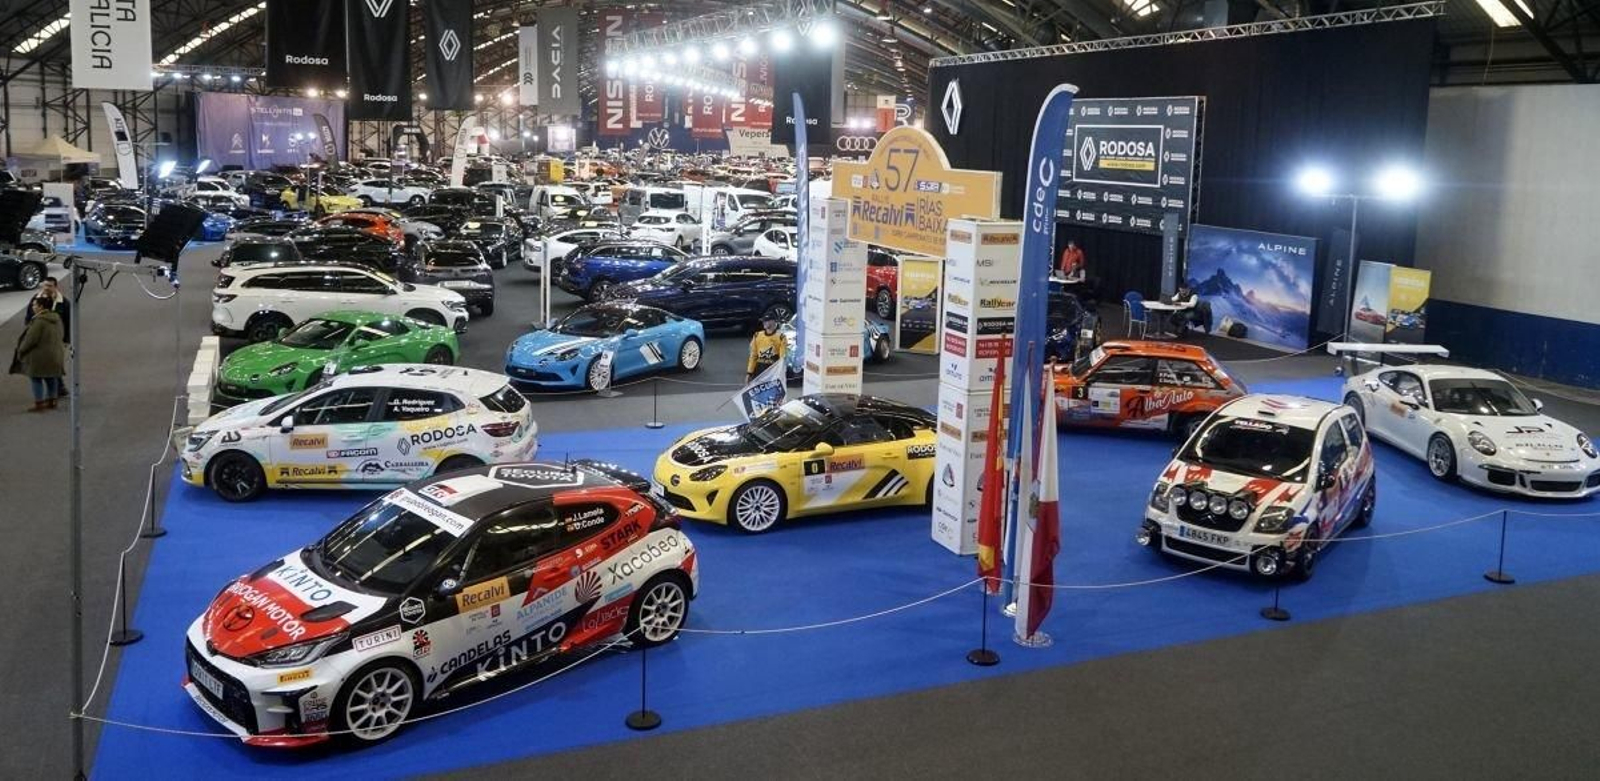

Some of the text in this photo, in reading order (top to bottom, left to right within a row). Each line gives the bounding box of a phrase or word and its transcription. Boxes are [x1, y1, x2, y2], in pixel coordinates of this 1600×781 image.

[285, 54, 329, 66] Rodosa
[363, 93, 398, 102] Rodosa
[1100, 141, 1155, 156] RODOSA
[885, 148, 919, 193] 57
[862, 200, 905, 227] Recalvi
[1257, 242, 1308, 257] ALPINE
[1077, 387, 1084, 398] 3
[292, 437, 325, 447] Recalvi
[411, 423, 478, 447] RODOSA
[292, 466, 326, 477] Recalvi
[830, 458, 863, 471] Recalvi
[600, 519, 642, 551] STARK
[607, 533, 679, 585] Xacobeo
[462, 584, 505, 608] Recalvi
[263, 602, 306, 641] MOTOR
[359, 629, 397, 649] TURINI
[440, 629, 512, 675] CANDELAS
